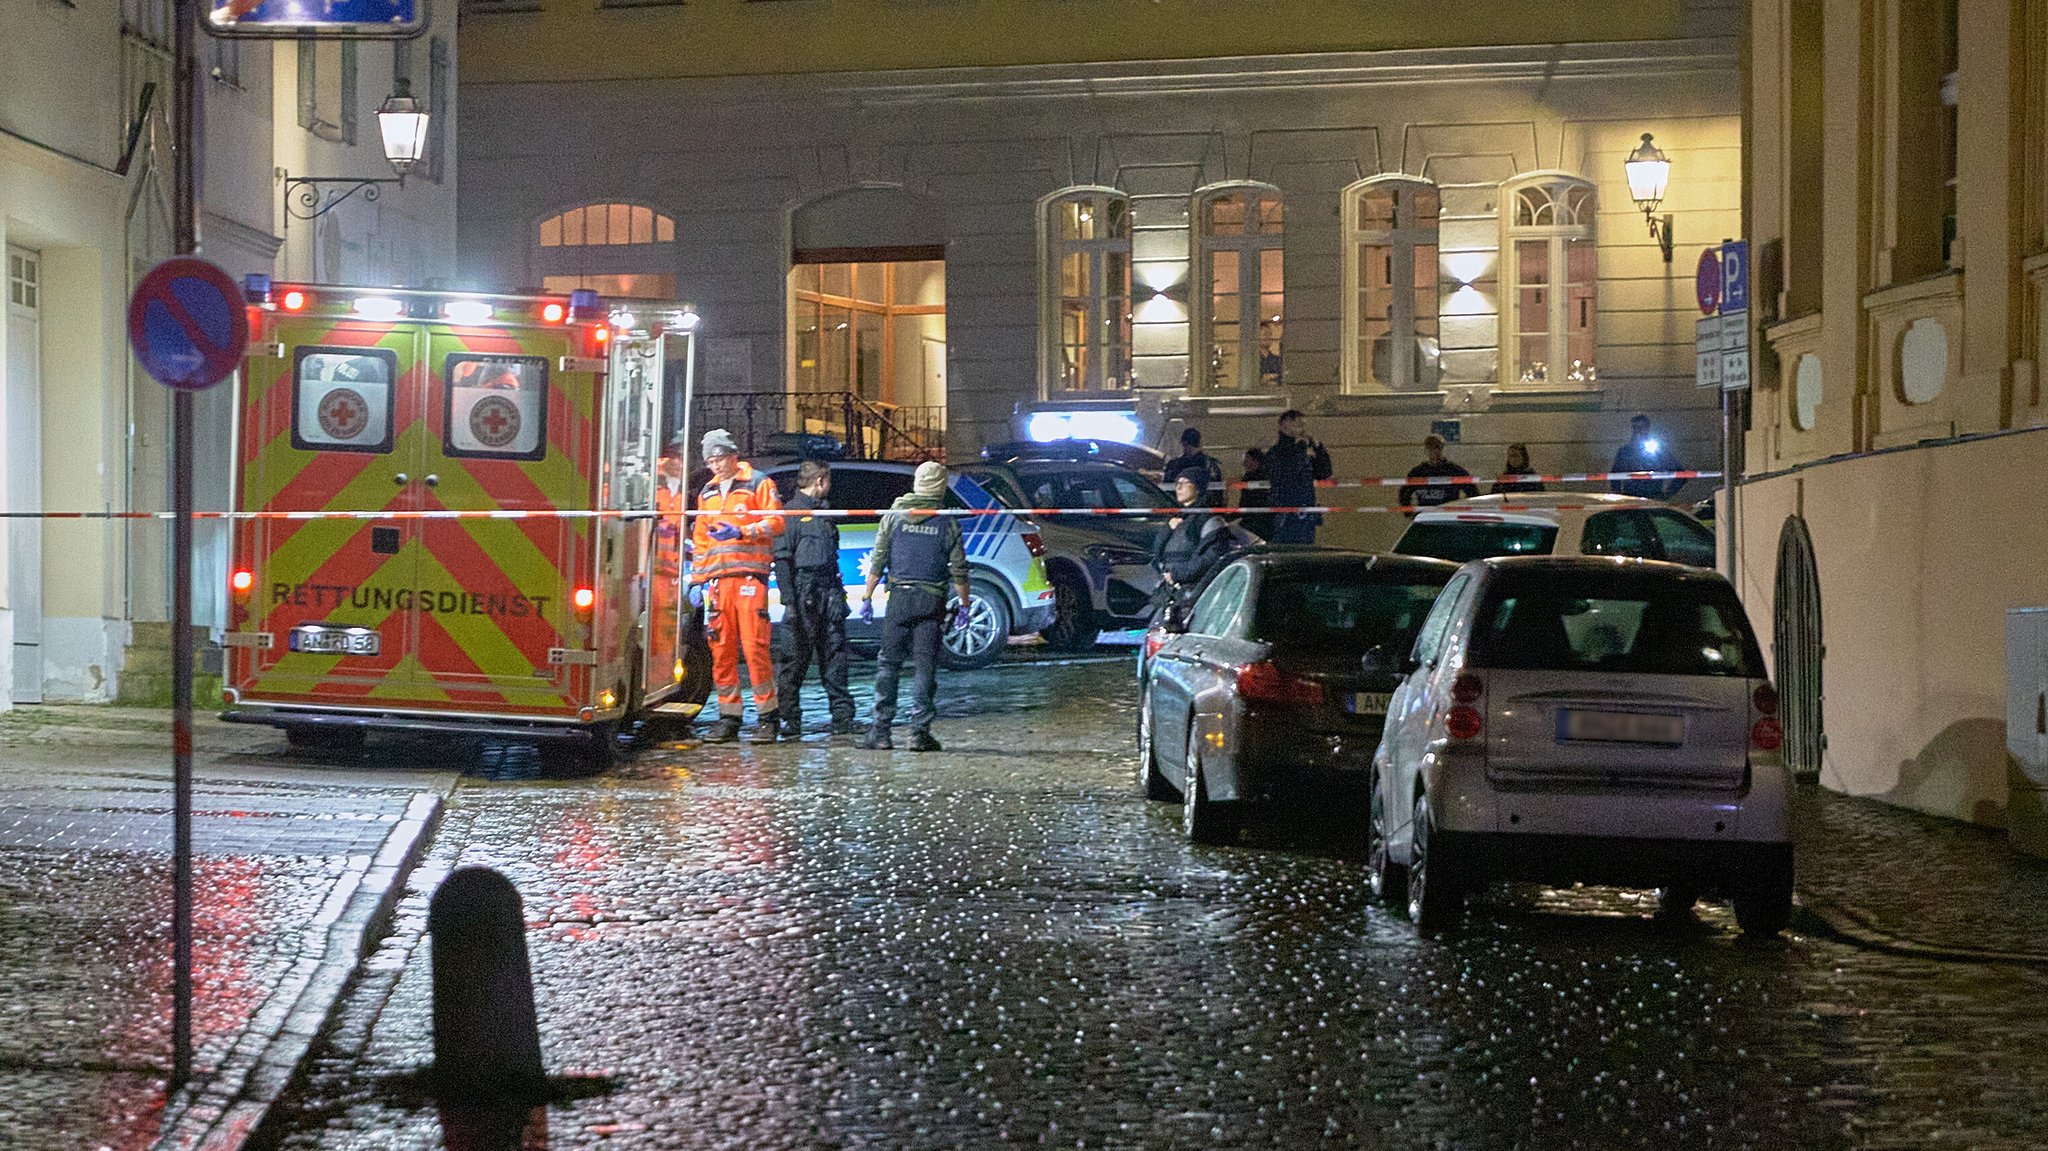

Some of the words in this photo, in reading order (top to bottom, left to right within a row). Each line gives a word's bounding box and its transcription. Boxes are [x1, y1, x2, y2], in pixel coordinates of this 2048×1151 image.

[1725, 252, 1740, 302] P
[902, 523, 939, 535] POLIZEI
[272, 583, 550, 618] RETTUNGSDIENST
